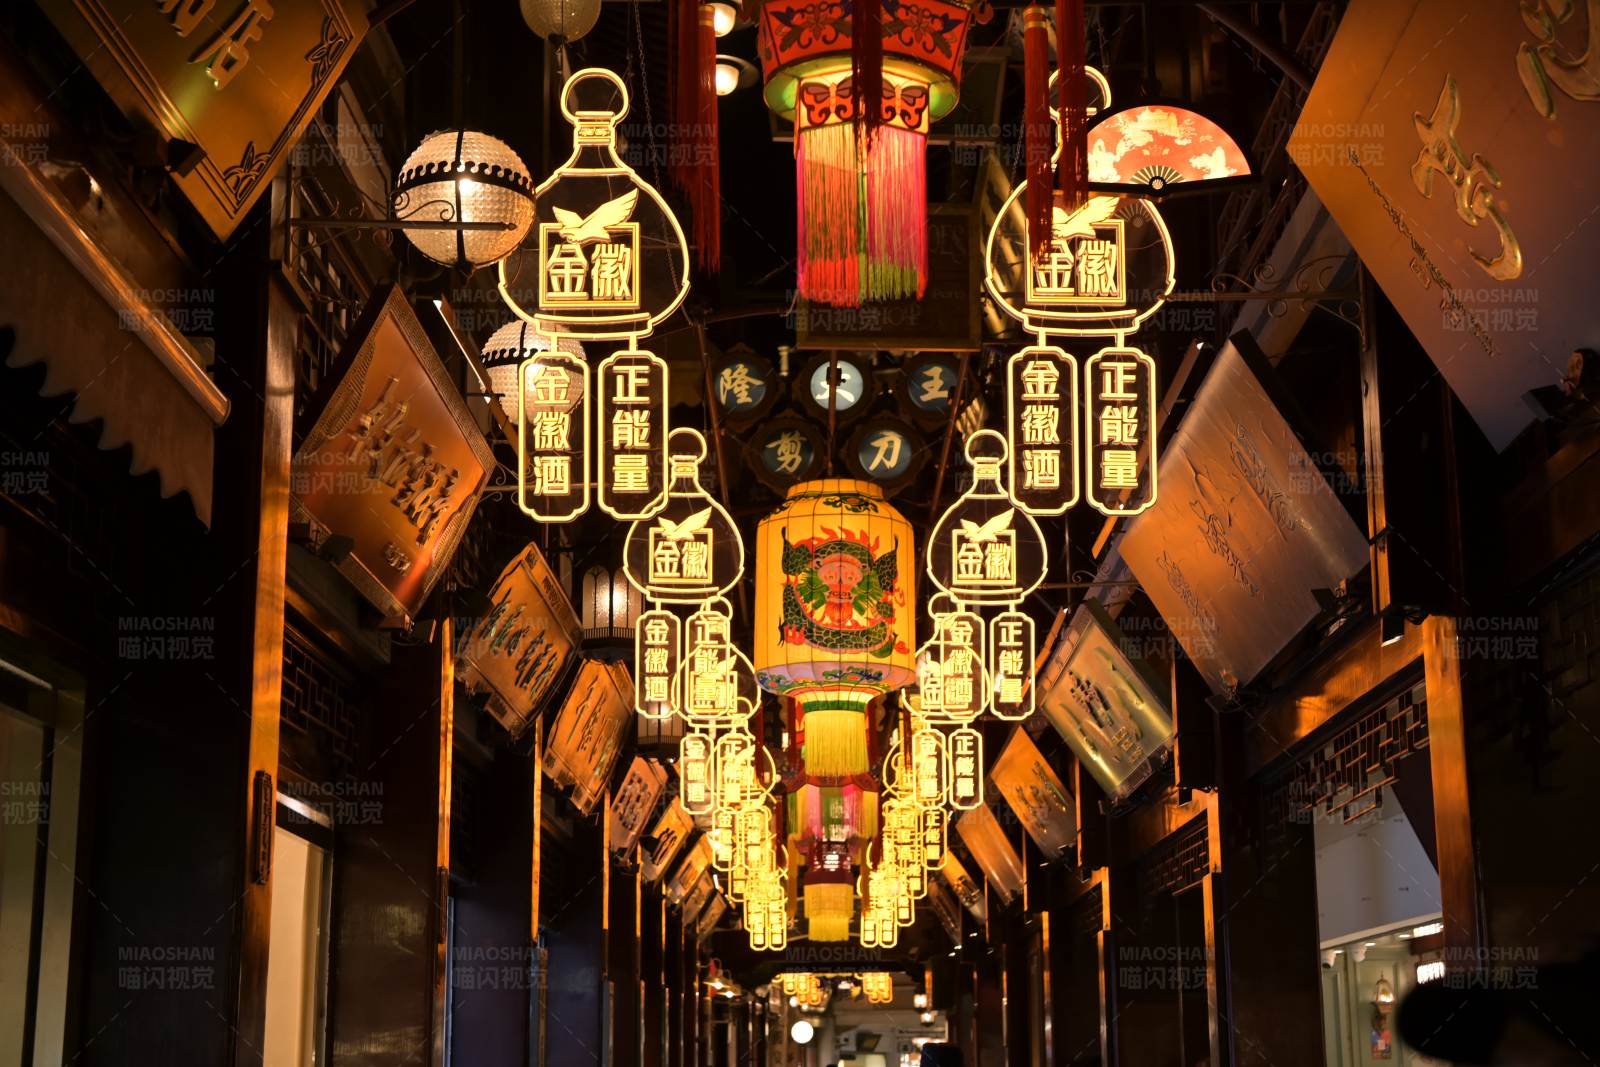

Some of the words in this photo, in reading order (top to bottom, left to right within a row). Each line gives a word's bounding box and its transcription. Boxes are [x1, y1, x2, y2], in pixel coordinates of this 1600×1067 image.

[546, 244, 632, 300] 金徽
[1034, 240, 1118, 296] 金徽
[533, 366, 571, 497] 金徽酒
[611, 365, 650, 493] 正能量
[1021, 360, 1060, 490] 金徽酒
[1100, 361, 1138, 489] 正能量
[654, 541, 708, 578] 金徽
[957, 542, 1011, 580] 金徽
[644, 619, 669, 702] 金徽酒
[998, 621, 1024, 703] 正能量
